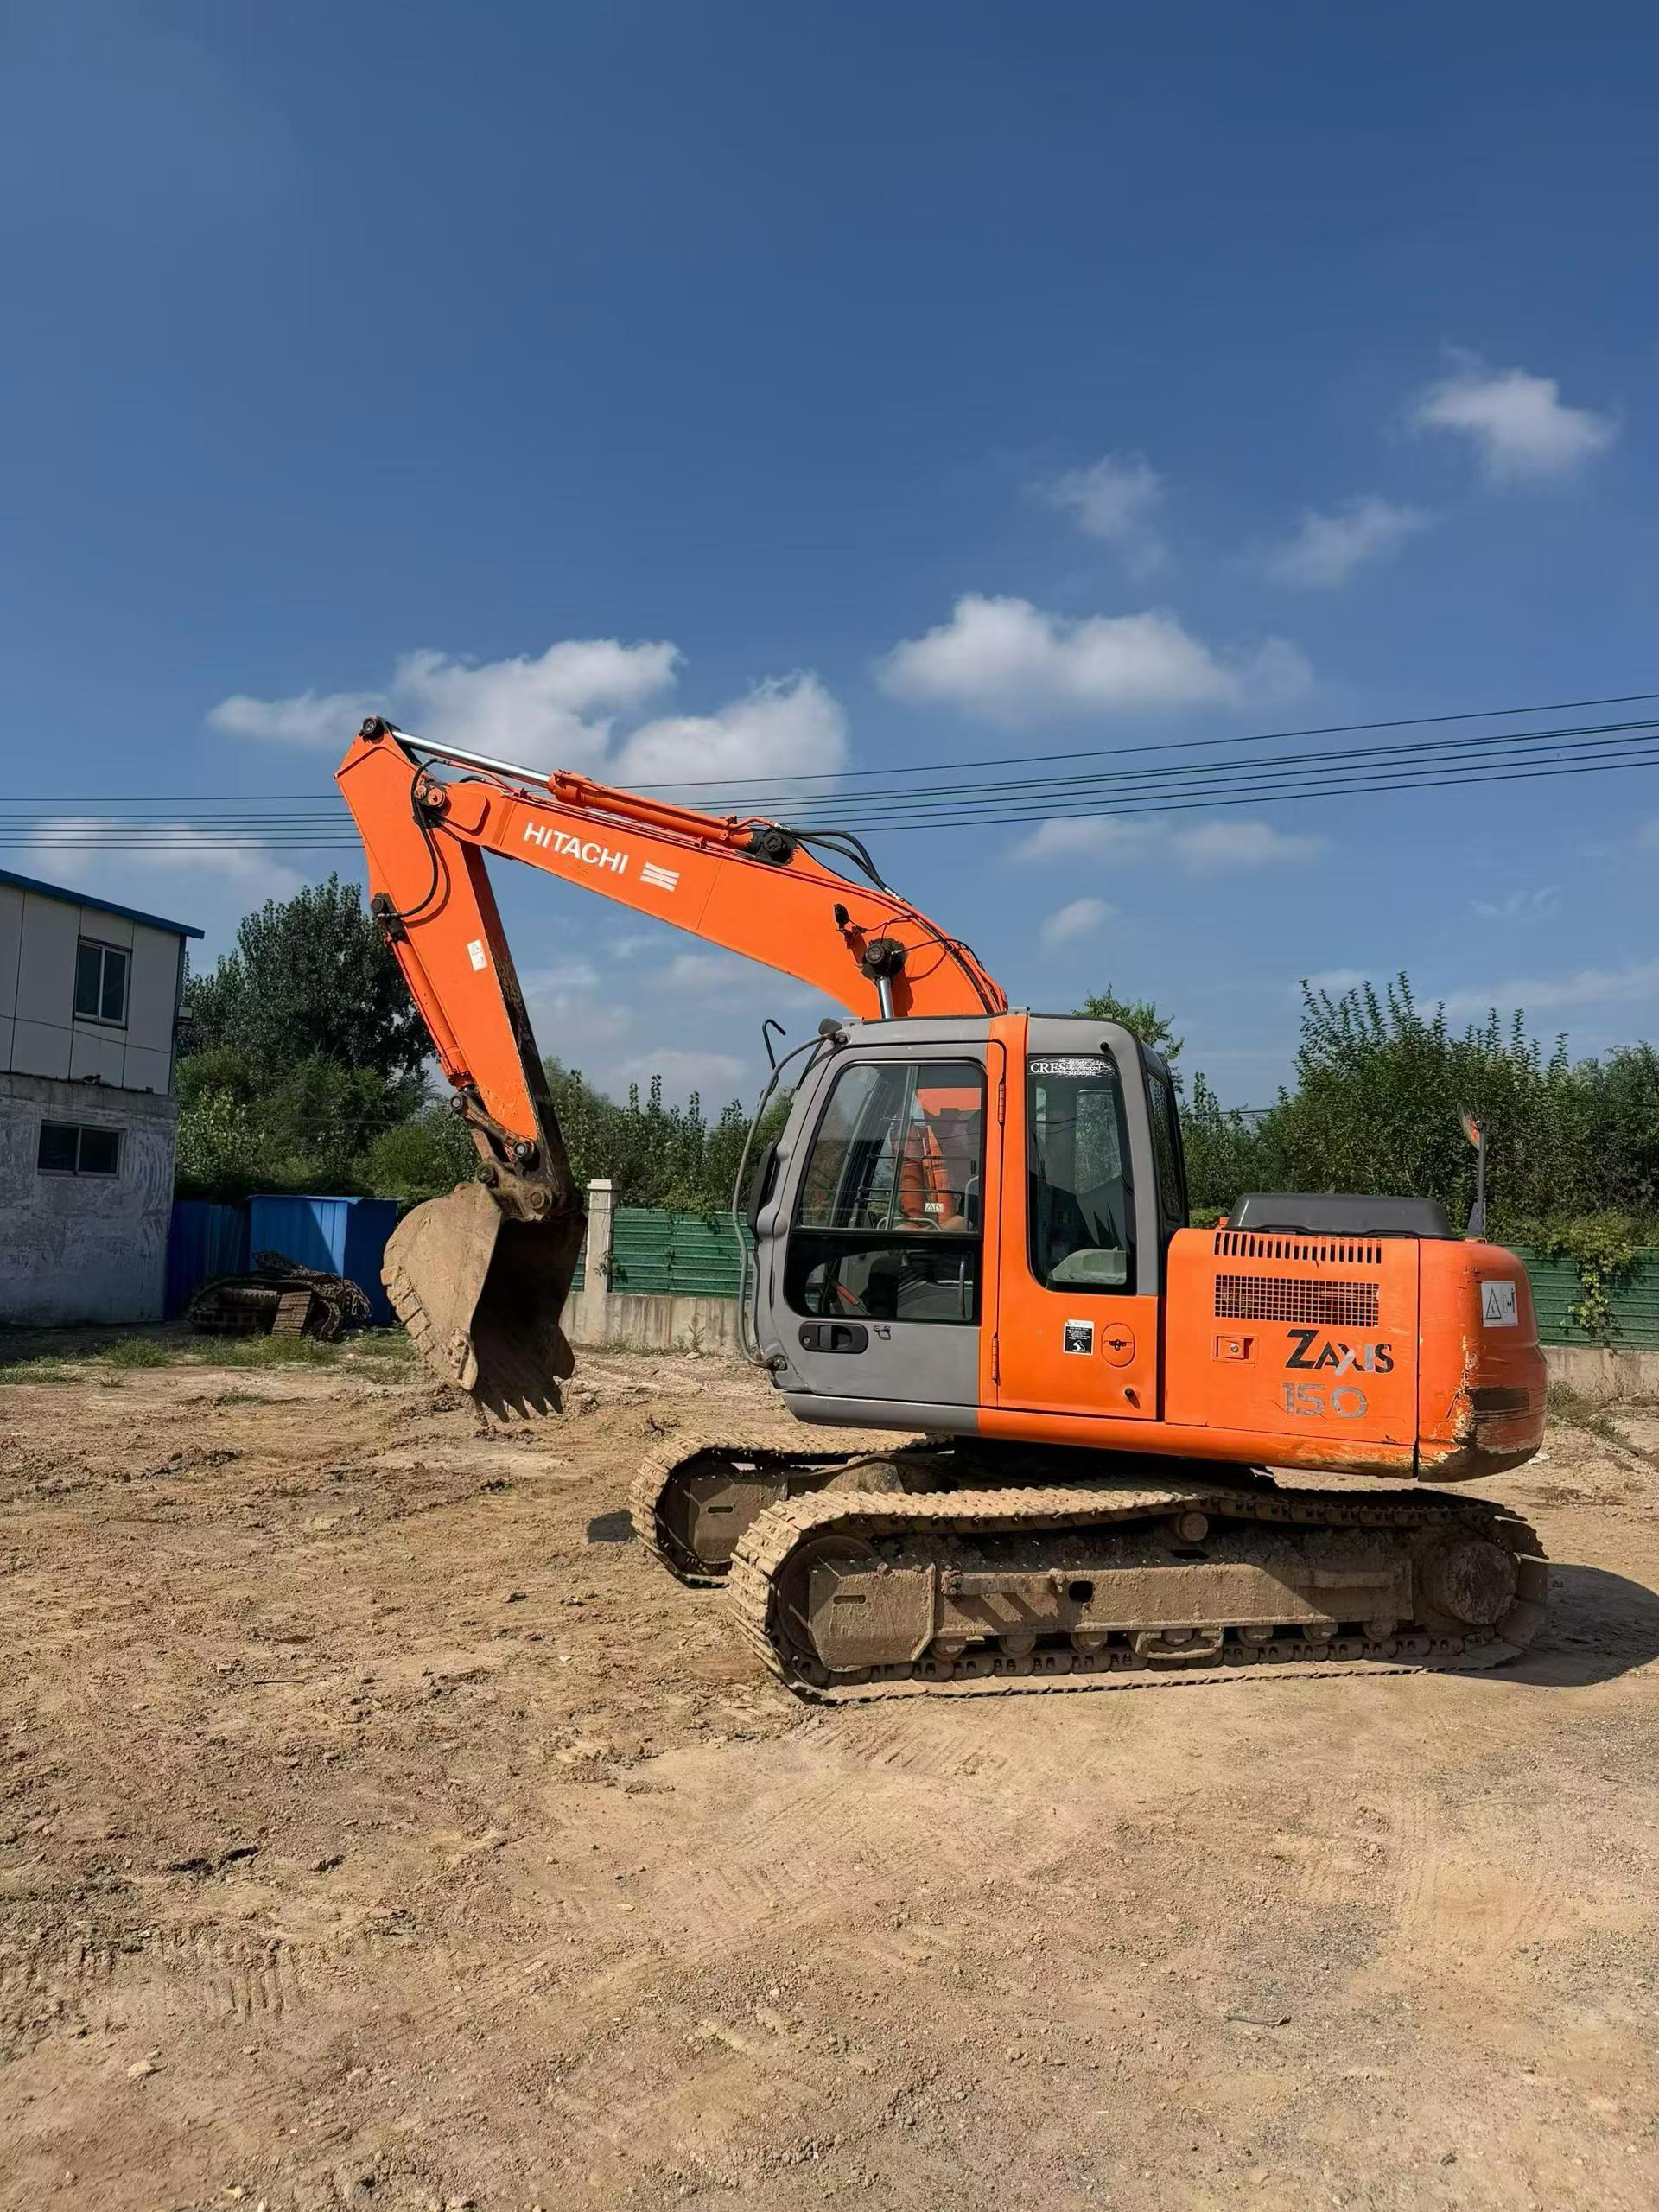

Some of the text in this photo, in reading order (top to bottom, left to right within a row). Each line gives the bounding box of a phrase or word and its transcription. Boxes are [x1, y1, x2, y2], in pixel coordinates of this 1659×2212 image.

[523, 822, 629, 874] HITACHI
[1030, 1062, 1066, 1073] CRES
[1282, 1382, 1369, 1419] 150
